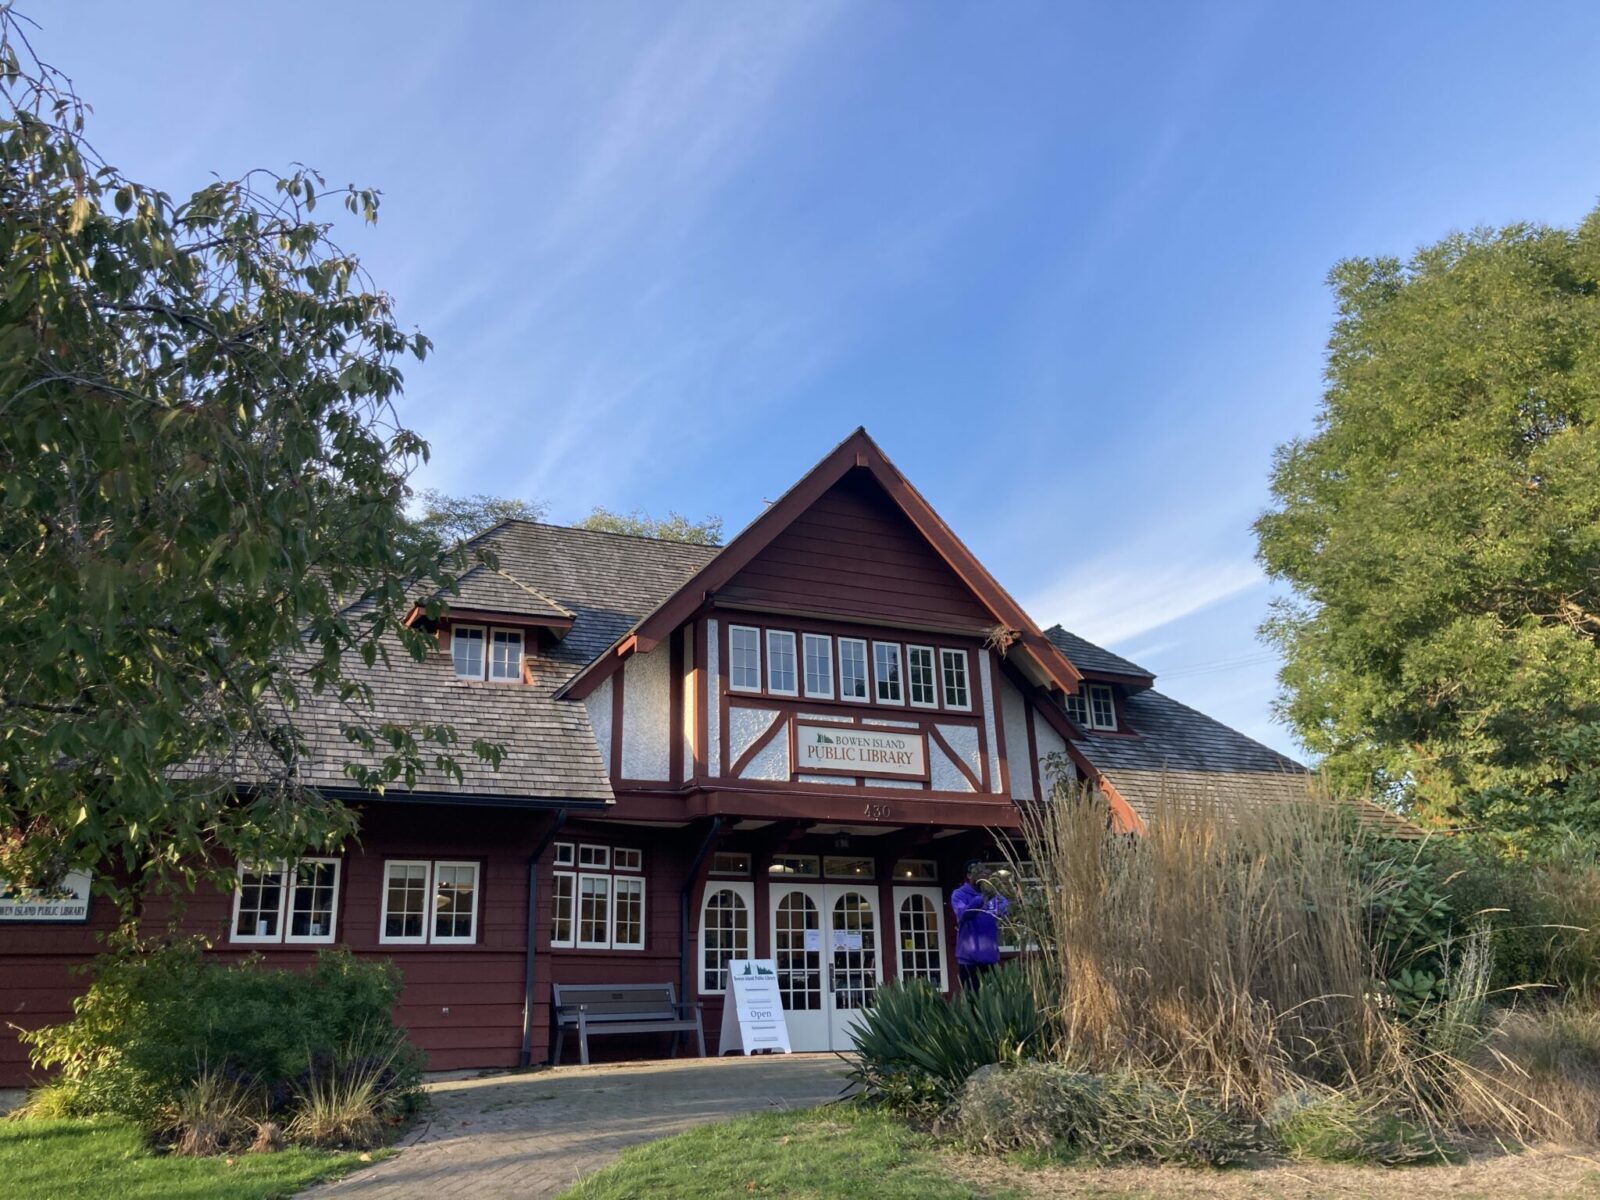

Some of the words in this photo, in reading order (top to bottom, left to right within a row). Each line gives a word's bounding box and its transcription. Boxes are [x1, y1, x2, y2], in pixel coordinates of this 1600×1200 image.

[836, 736, 870, 746] BOWEN
[873, 740, 905, 749] ISLAND
[808, 745, 855, 761] PUBLIC
[859, 748, 913, 764] LIBRARY
[864, 804, 890, 817] 430
[37, 906, 58, 915] PUBLIC
[60, 906, 85, 916] LIBRARY
[750, 1010, 772, 1020] Open
